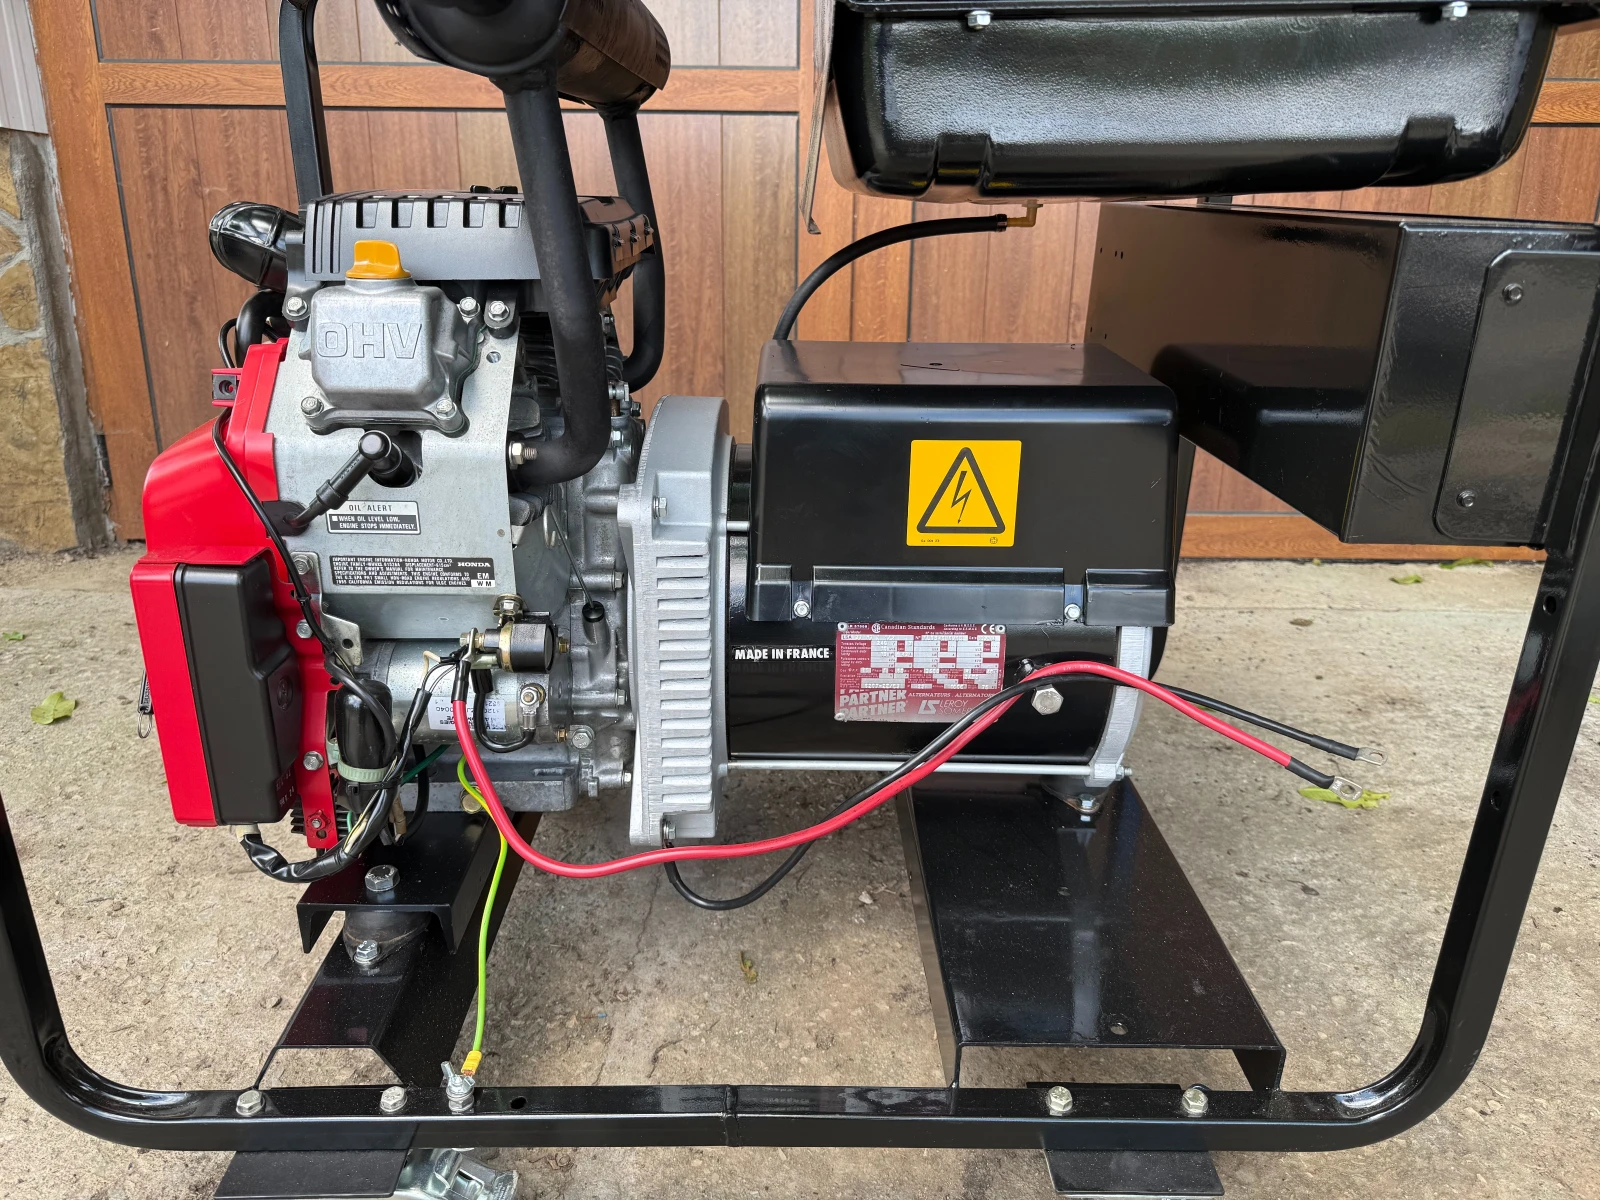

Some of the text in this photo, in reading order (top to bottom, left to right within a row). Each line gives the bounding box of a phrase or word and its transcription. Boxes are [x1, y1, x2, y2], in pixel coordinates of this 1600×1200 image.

[316, 322, 422, 359] OHV
[734, 648, 830, 660] MADE IN FRANCE
